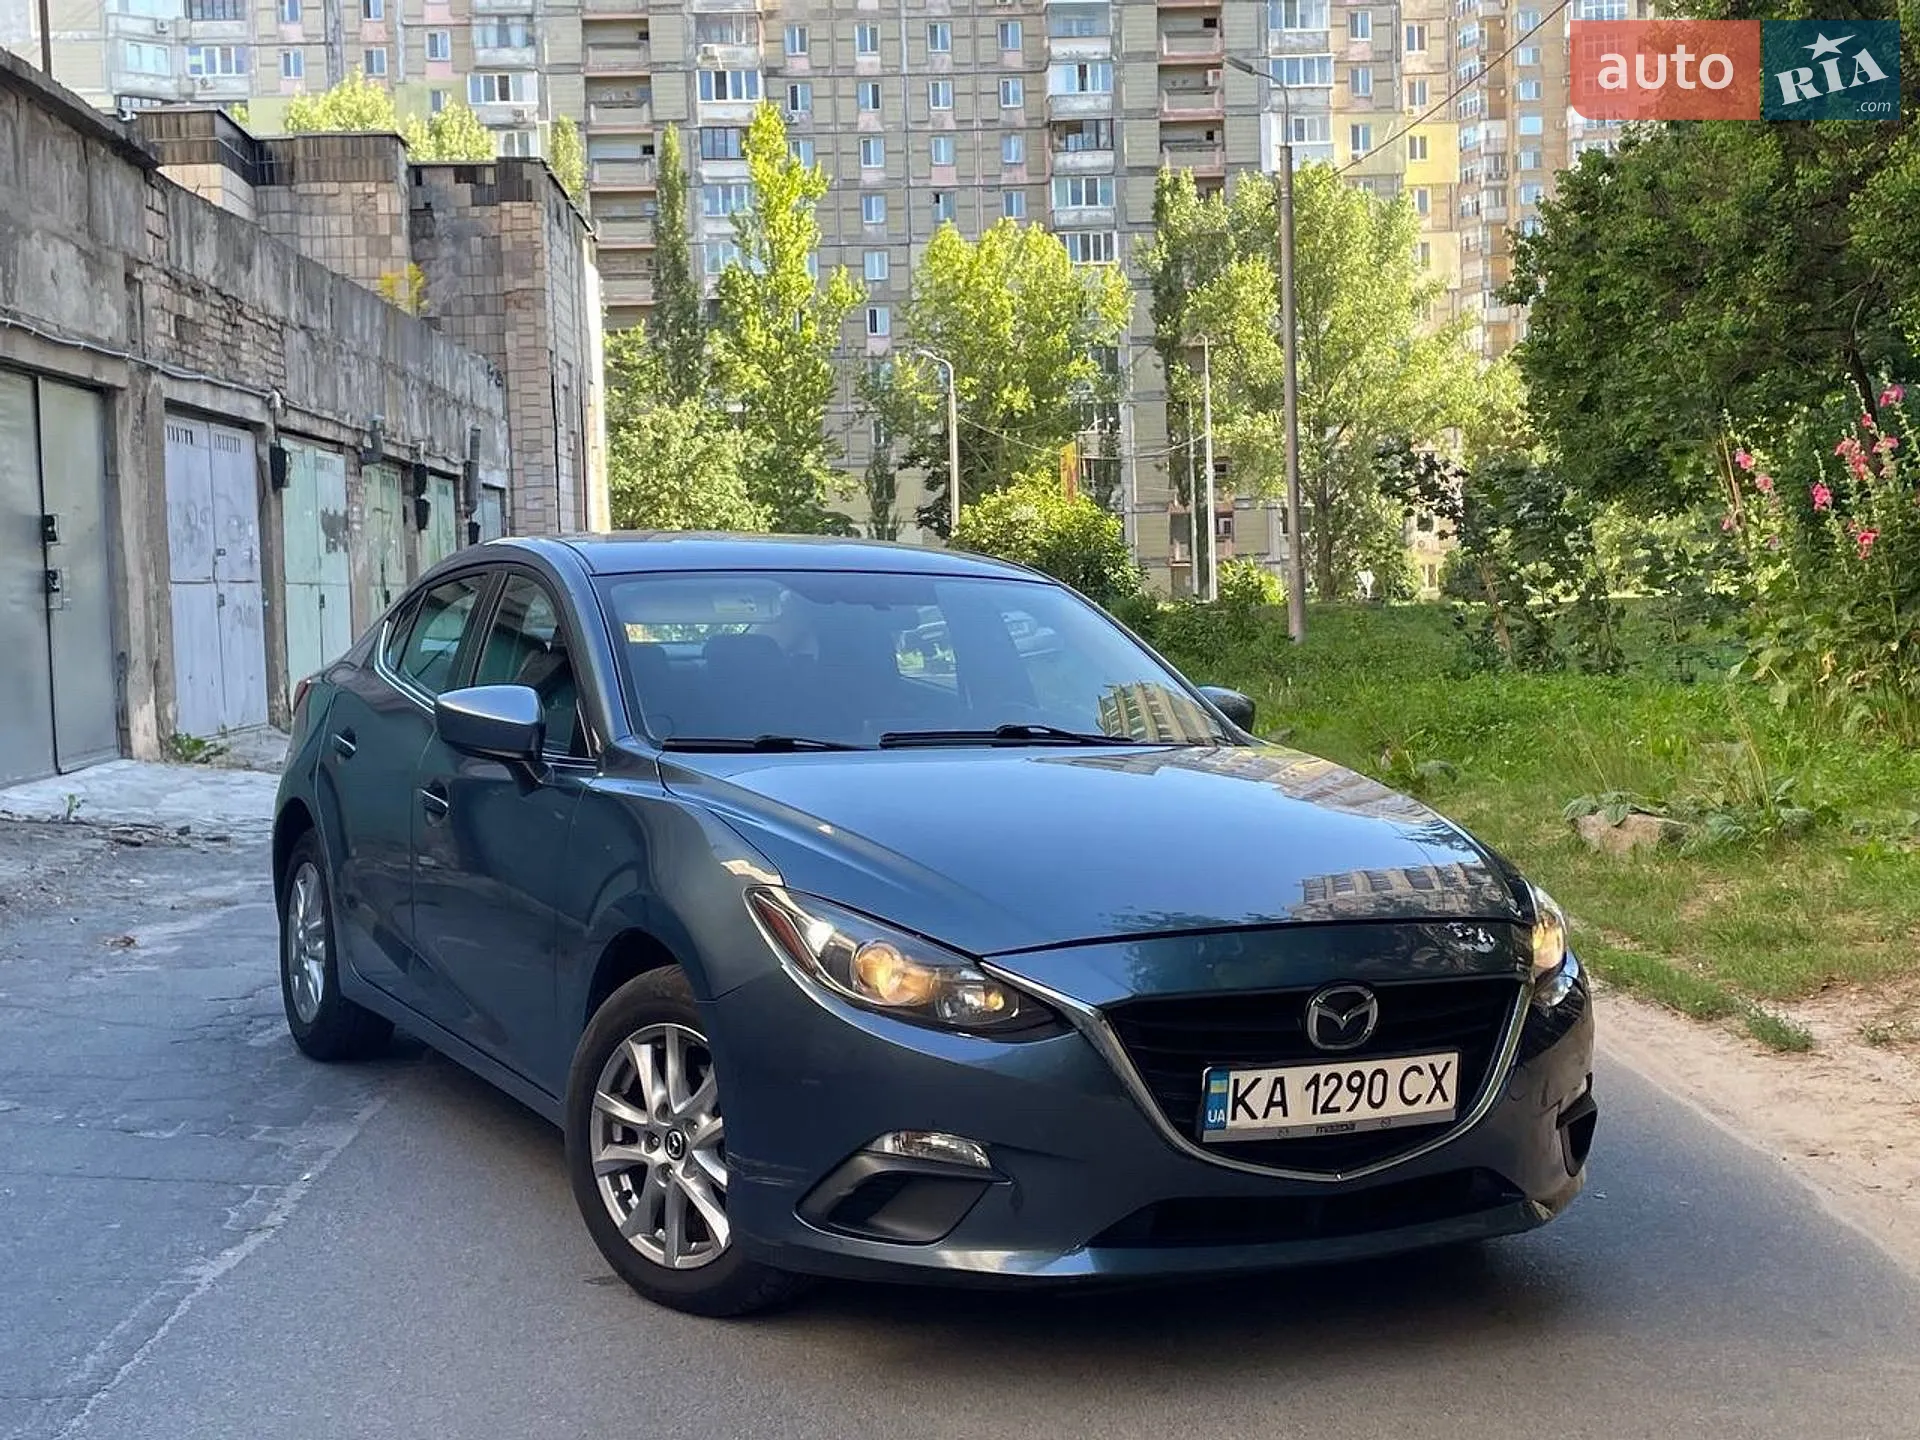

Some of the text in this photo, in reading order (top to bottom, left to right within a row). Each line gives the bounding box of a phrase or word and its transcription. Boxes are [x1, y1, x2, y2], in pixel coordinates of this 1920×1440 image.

[1231, 1061, 1452, 1121] KA 1290 CX
[1207, 1110, 1225, 1123] UA
